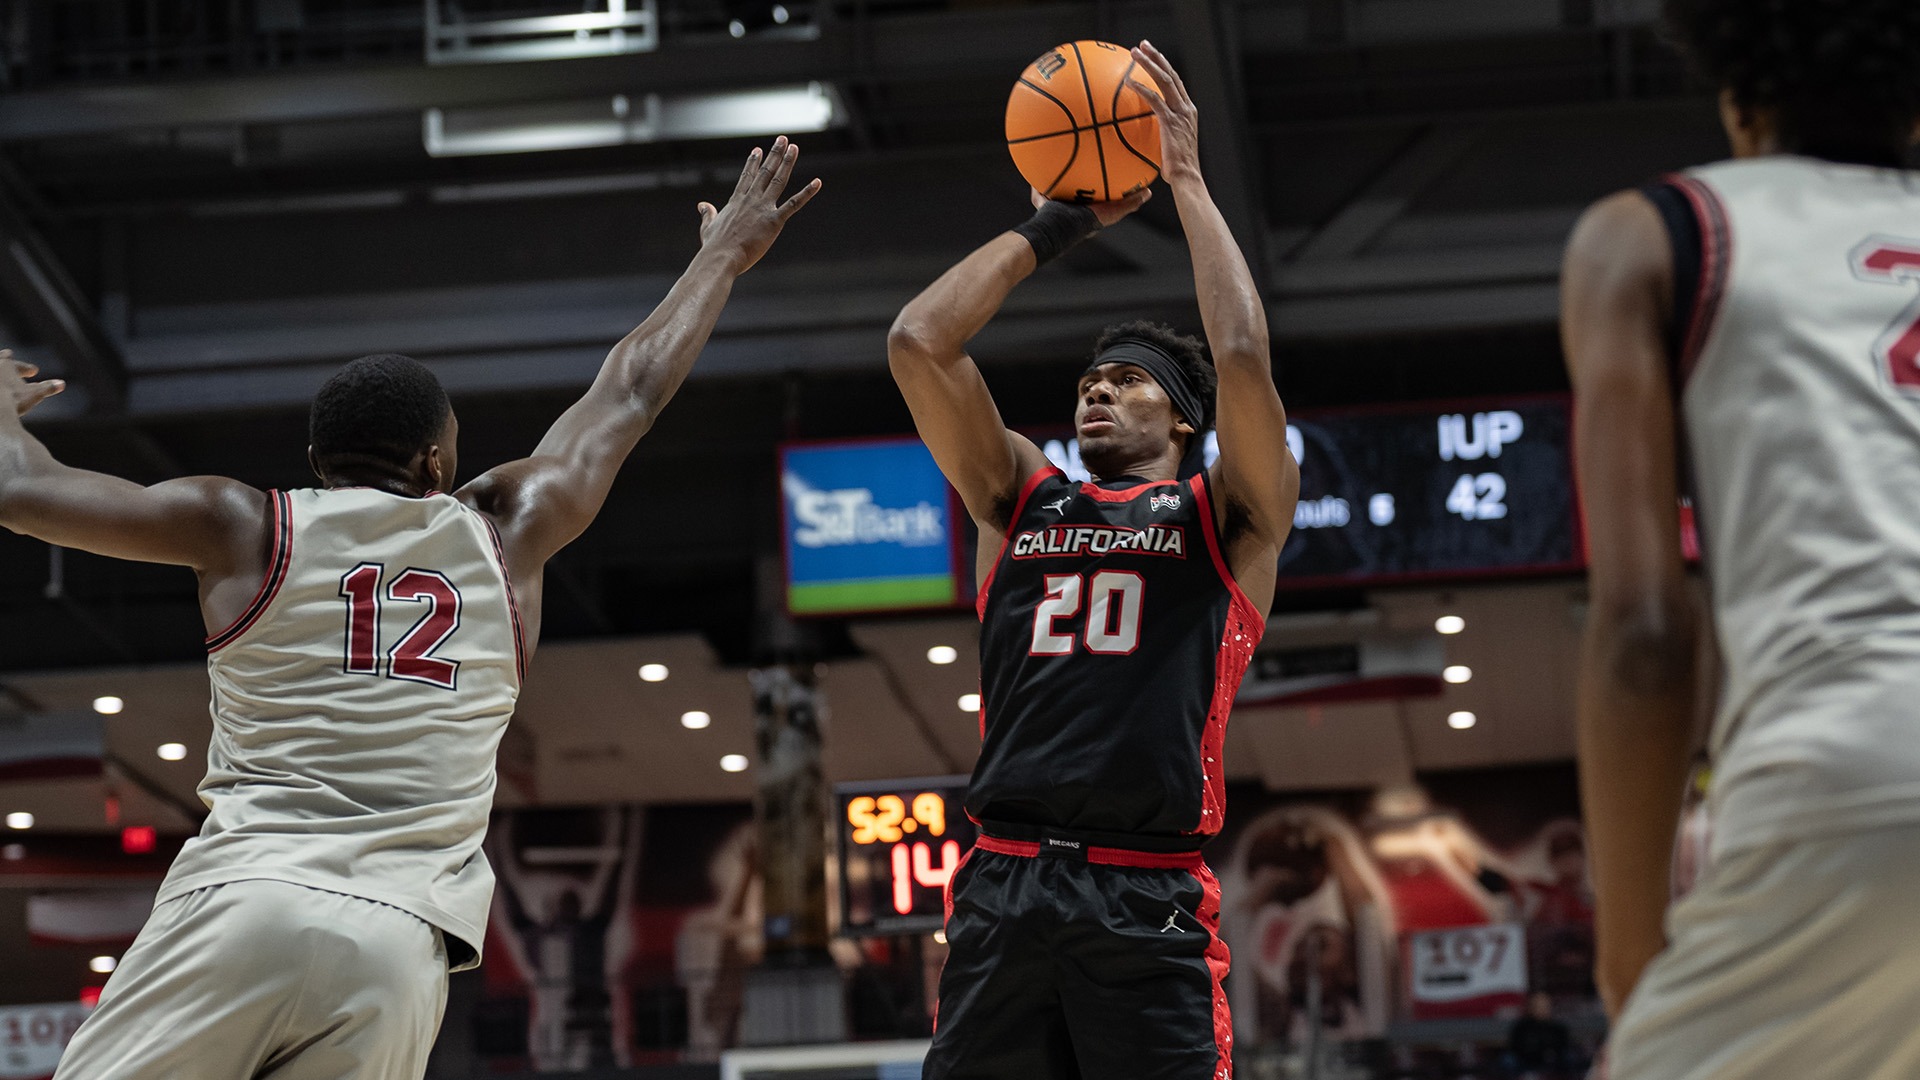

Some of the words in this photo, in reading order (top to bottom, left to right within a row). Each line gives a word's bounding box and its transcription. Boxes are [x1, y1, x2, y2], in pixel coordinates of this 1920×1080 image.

[1438, 410, 1524, 461] IUP
[1293, 494, 1350, 529] ouls
[1446, 472, 1508, 520] 42
[1013, 524, 1186, 559] CALIFORNIA
[338, 561, 462, 691] 12
[1028, 569, 1146, 656] 20
[848, 792, 946, 844] 52.9
[891, 839, 960, 915] 14
[1424, 930, 1508, 972] 107
